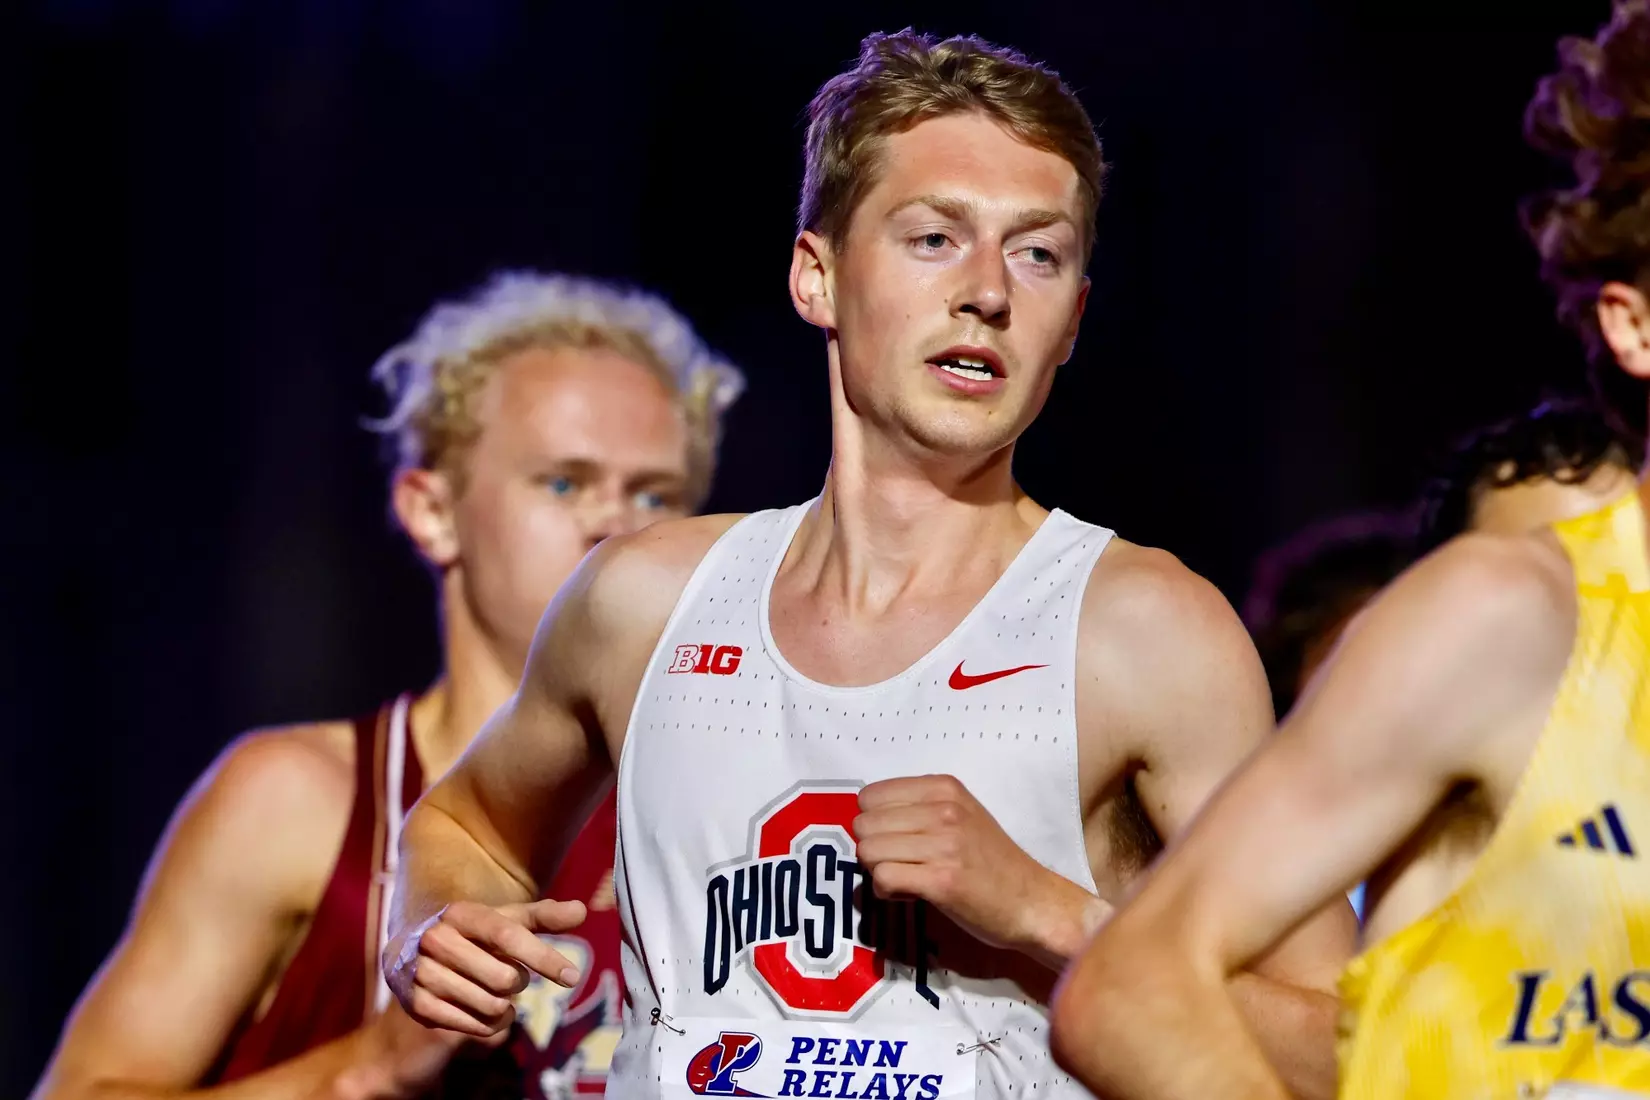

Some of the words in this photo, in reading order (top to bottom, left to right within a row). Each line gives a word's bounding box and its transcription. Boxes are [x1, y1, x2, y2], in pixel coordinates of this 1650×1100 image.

[703, 858, 801, 996] OHIO
[785, 1036, 908, 1068] PENN
[777, 1068, 943, 1100] RELAYS
